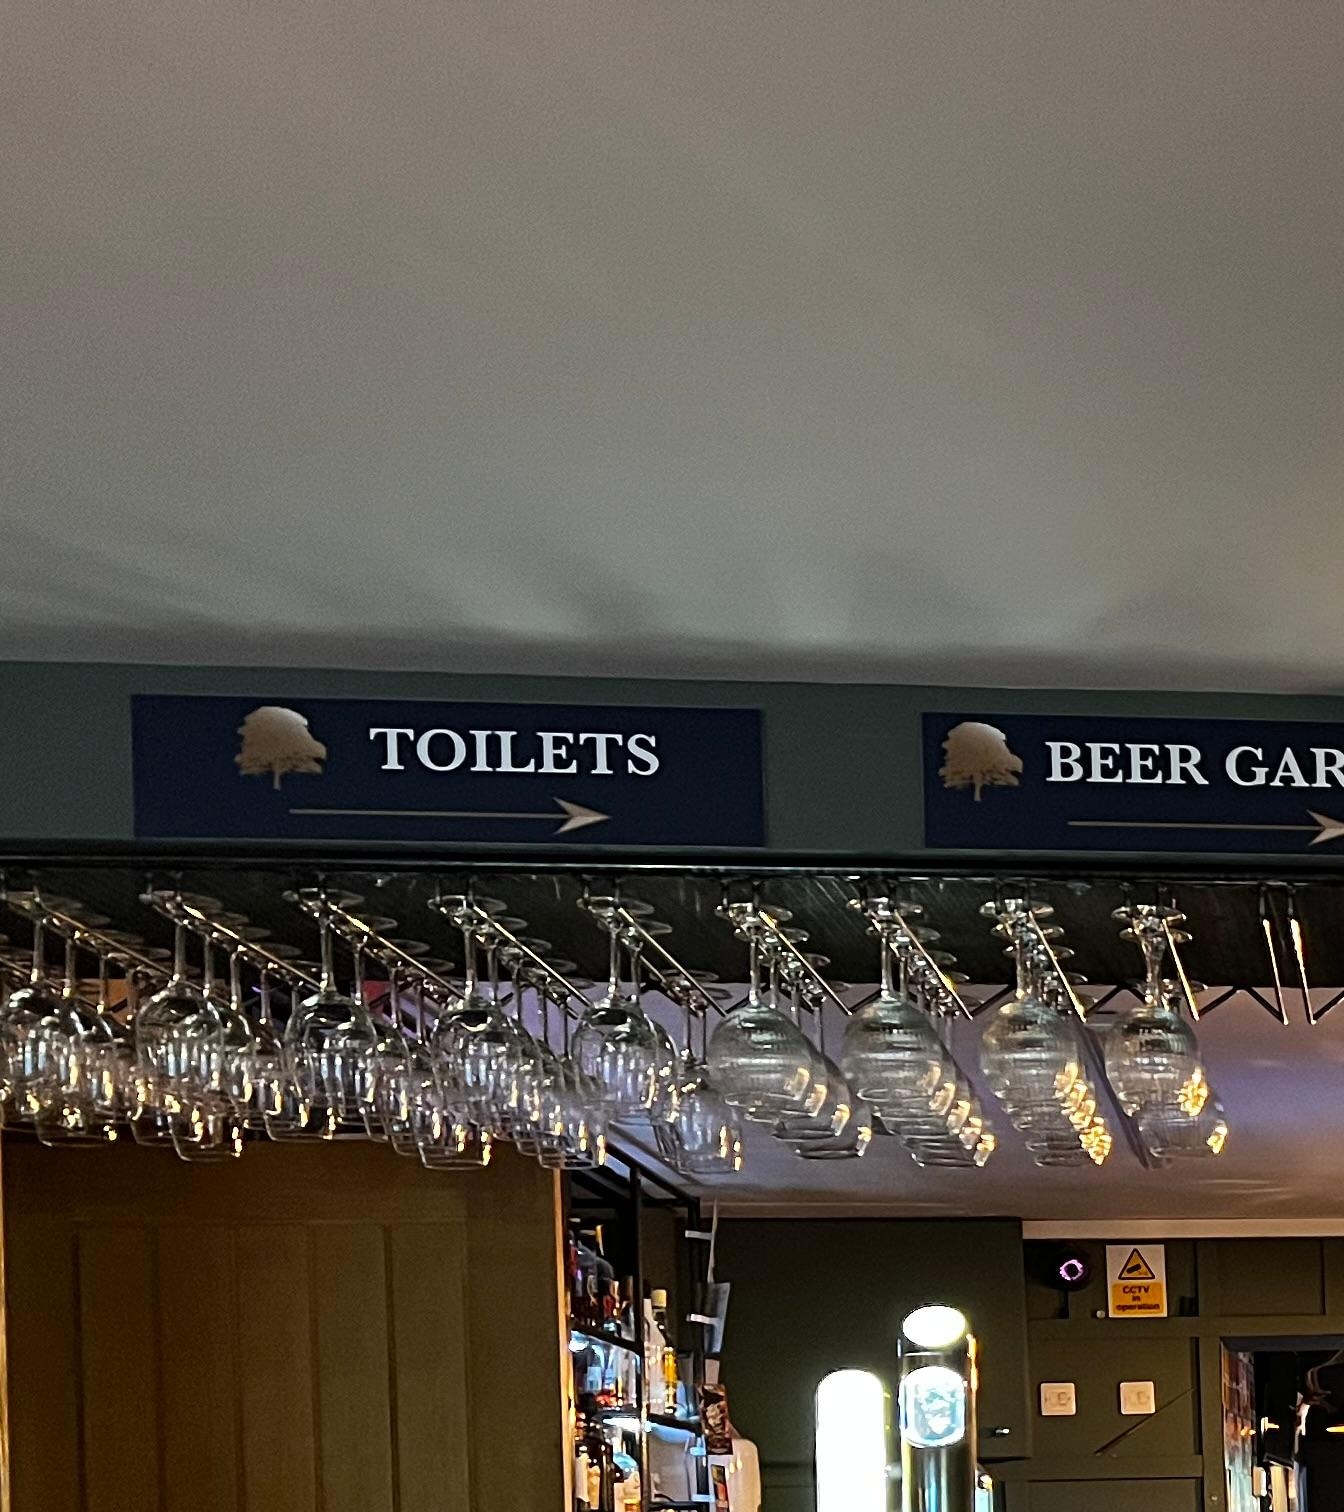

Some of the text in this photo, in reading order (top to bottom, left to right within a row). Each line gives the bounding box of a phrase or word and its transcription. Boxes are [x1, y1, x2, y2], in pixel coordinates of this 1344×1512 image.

[368, 727, 661, 777] TOILETS
[1043, 741, 1210, 786] BEER
[1122, 1285, 1150, 1294] CCTV
